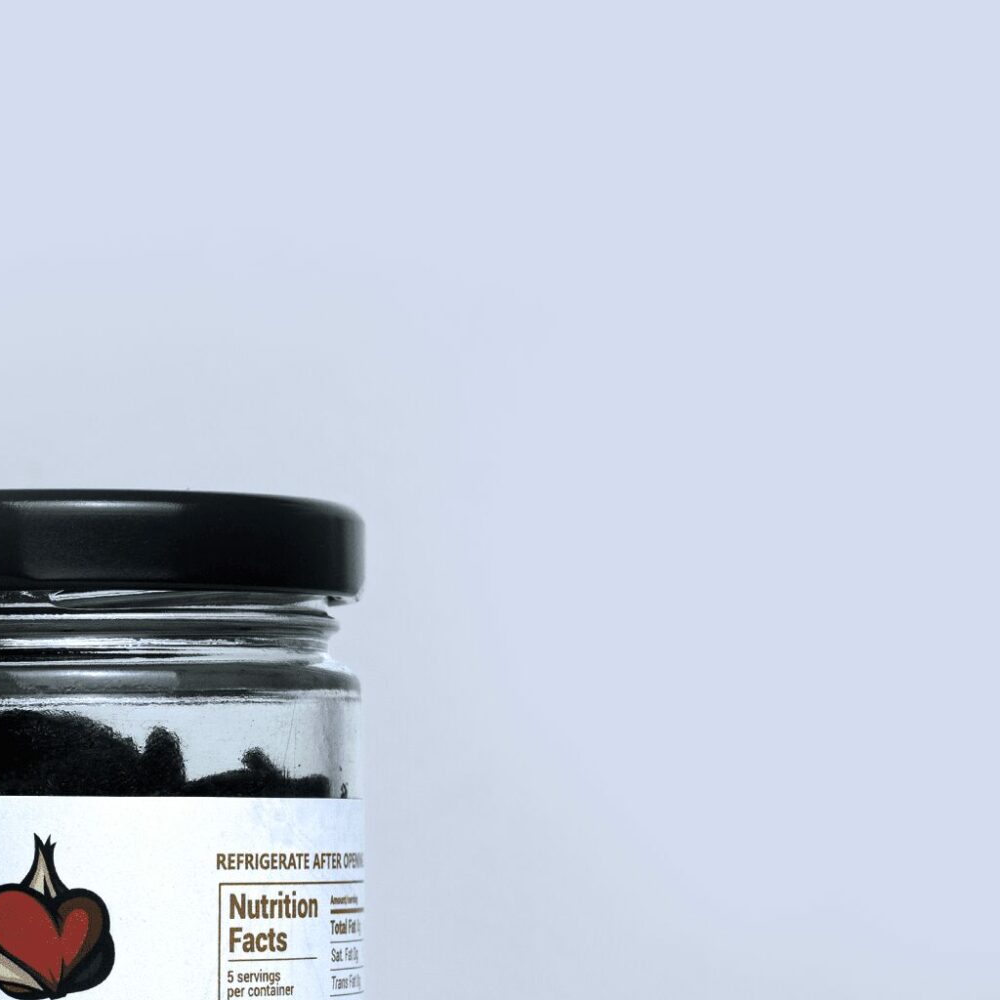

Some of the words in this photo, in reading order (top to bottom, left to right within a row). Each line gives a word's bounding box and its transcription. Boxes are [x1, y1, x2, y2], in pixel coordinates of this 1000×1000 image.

[216, 852, 310, 870] REFRIGERATE
[312, 852, 342, 869] AFTER
[229, 890, 318, 919] Nutrition
[330, 919, 347, 935] Total
[229, 927, 288, 953] Facts
[227, 970, 234, 983] 5
[237, 969, 281, 986] servings
[332, 975, 348, 990] Trans
[227, 987, 245, 1000] per
[248, 983, 294, 998] container
